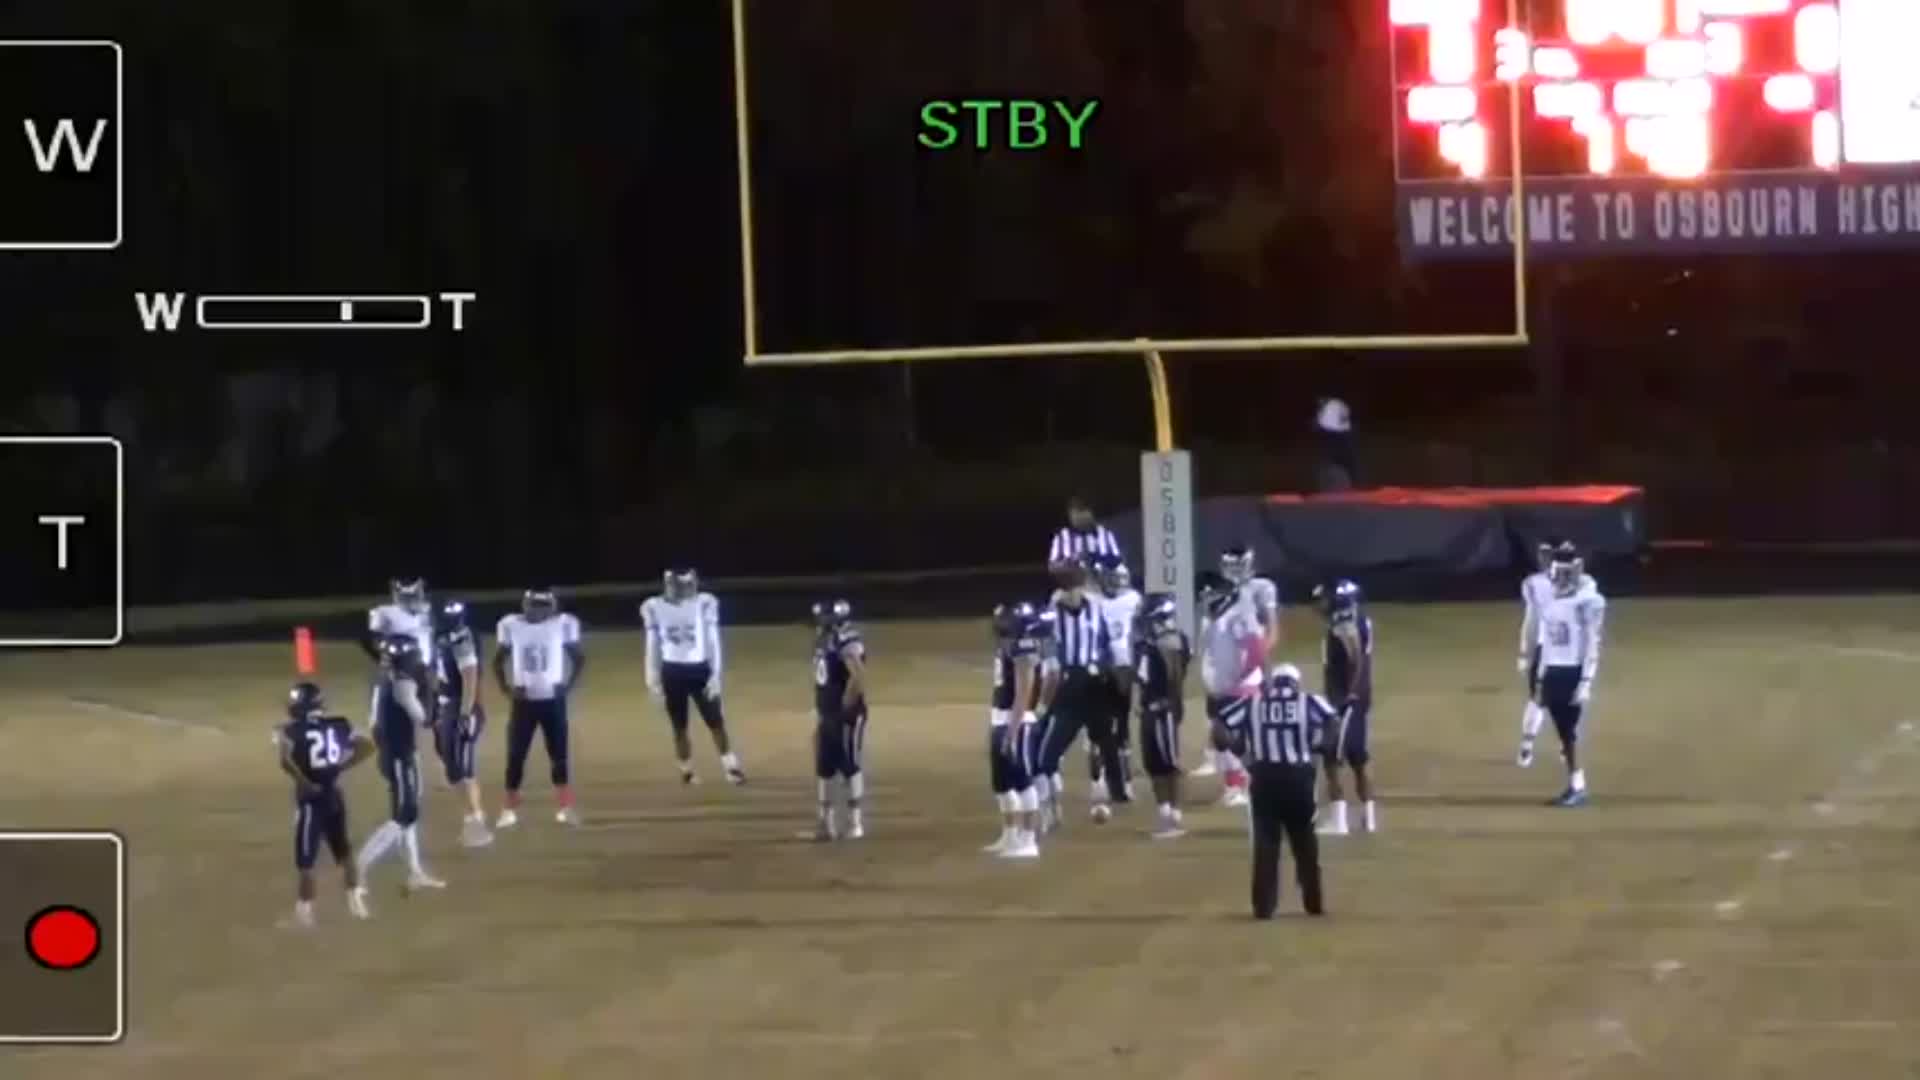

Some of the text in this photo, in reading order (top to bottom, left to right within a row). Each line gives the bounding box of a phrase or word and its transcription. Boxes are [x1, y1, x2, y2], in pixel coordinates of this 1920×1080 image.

[1409, 194, 1575, 245] WELCOME
[1593, 191, 1634, 240] TO
[1654, 186, 1818, 239] OSBOURN
[305, 727, 341, 769] 26
